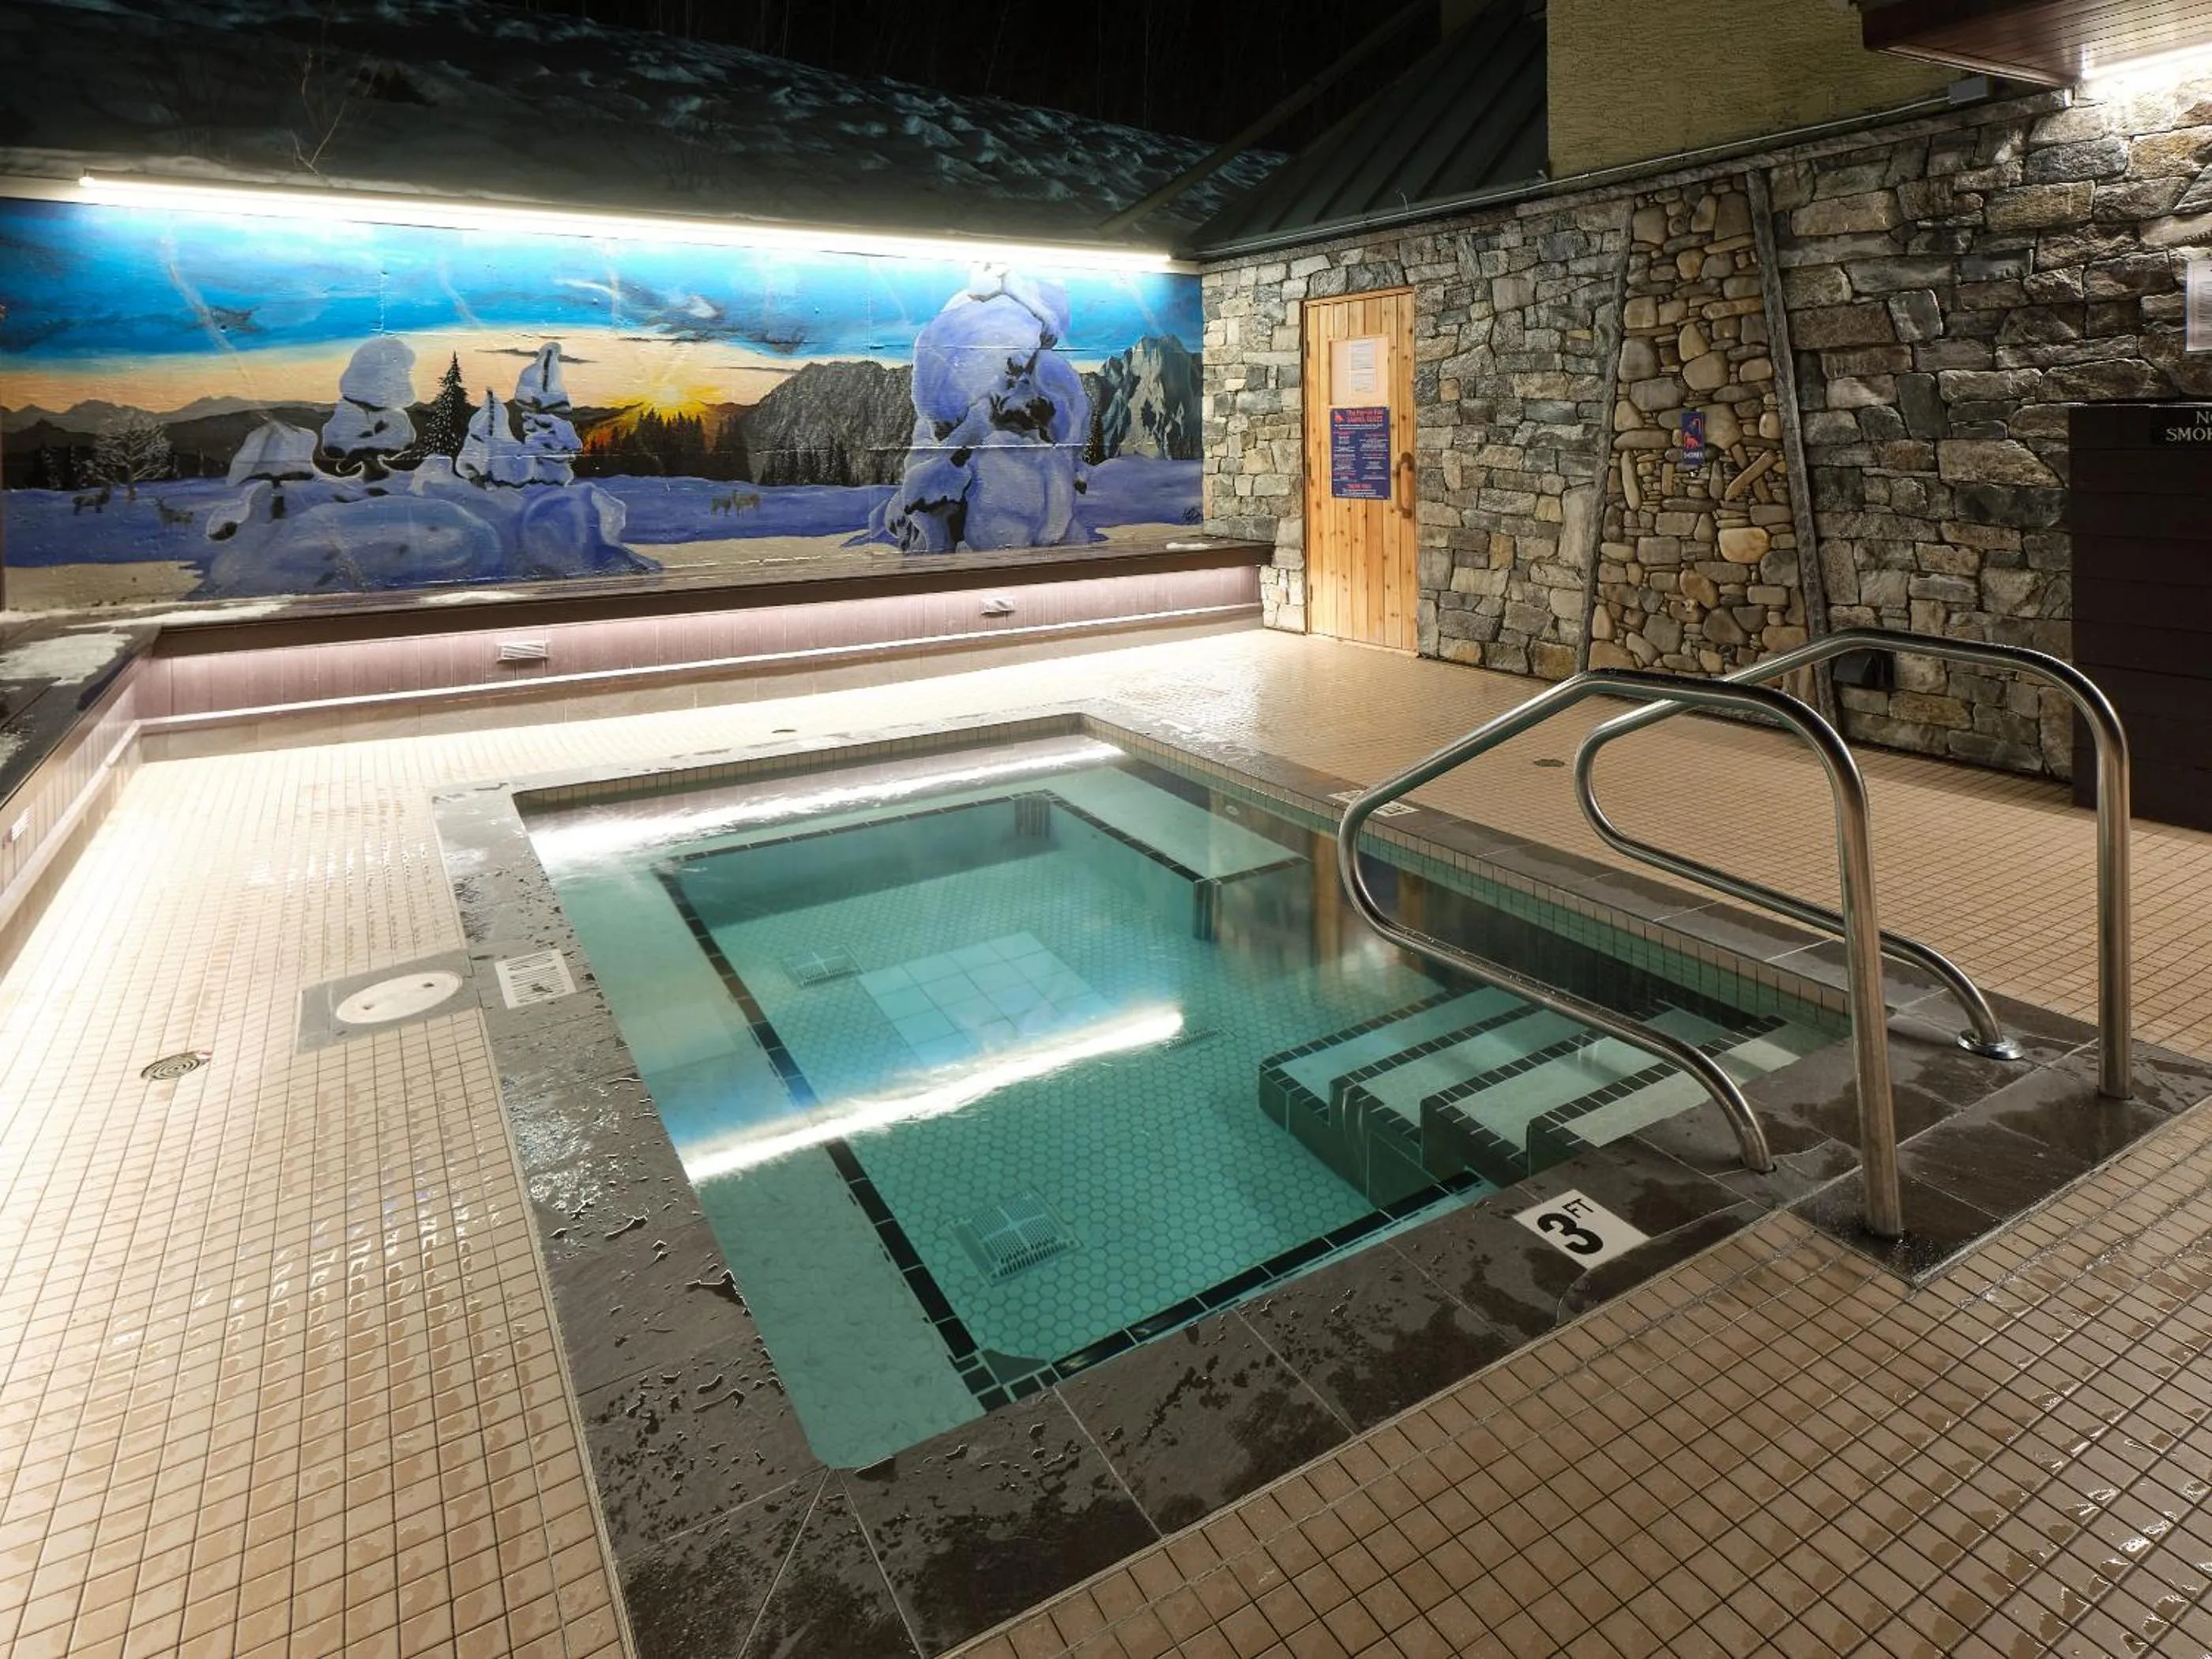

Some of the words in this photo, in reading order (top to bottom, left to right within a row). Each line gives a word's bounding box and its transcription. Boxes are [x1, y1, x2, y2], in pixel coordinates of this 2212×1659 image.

[2196, 410, 2212, 423] N
[1562, 1198, 1593, 1218] FT
[1537, 1213, 1604, 1255] 3
